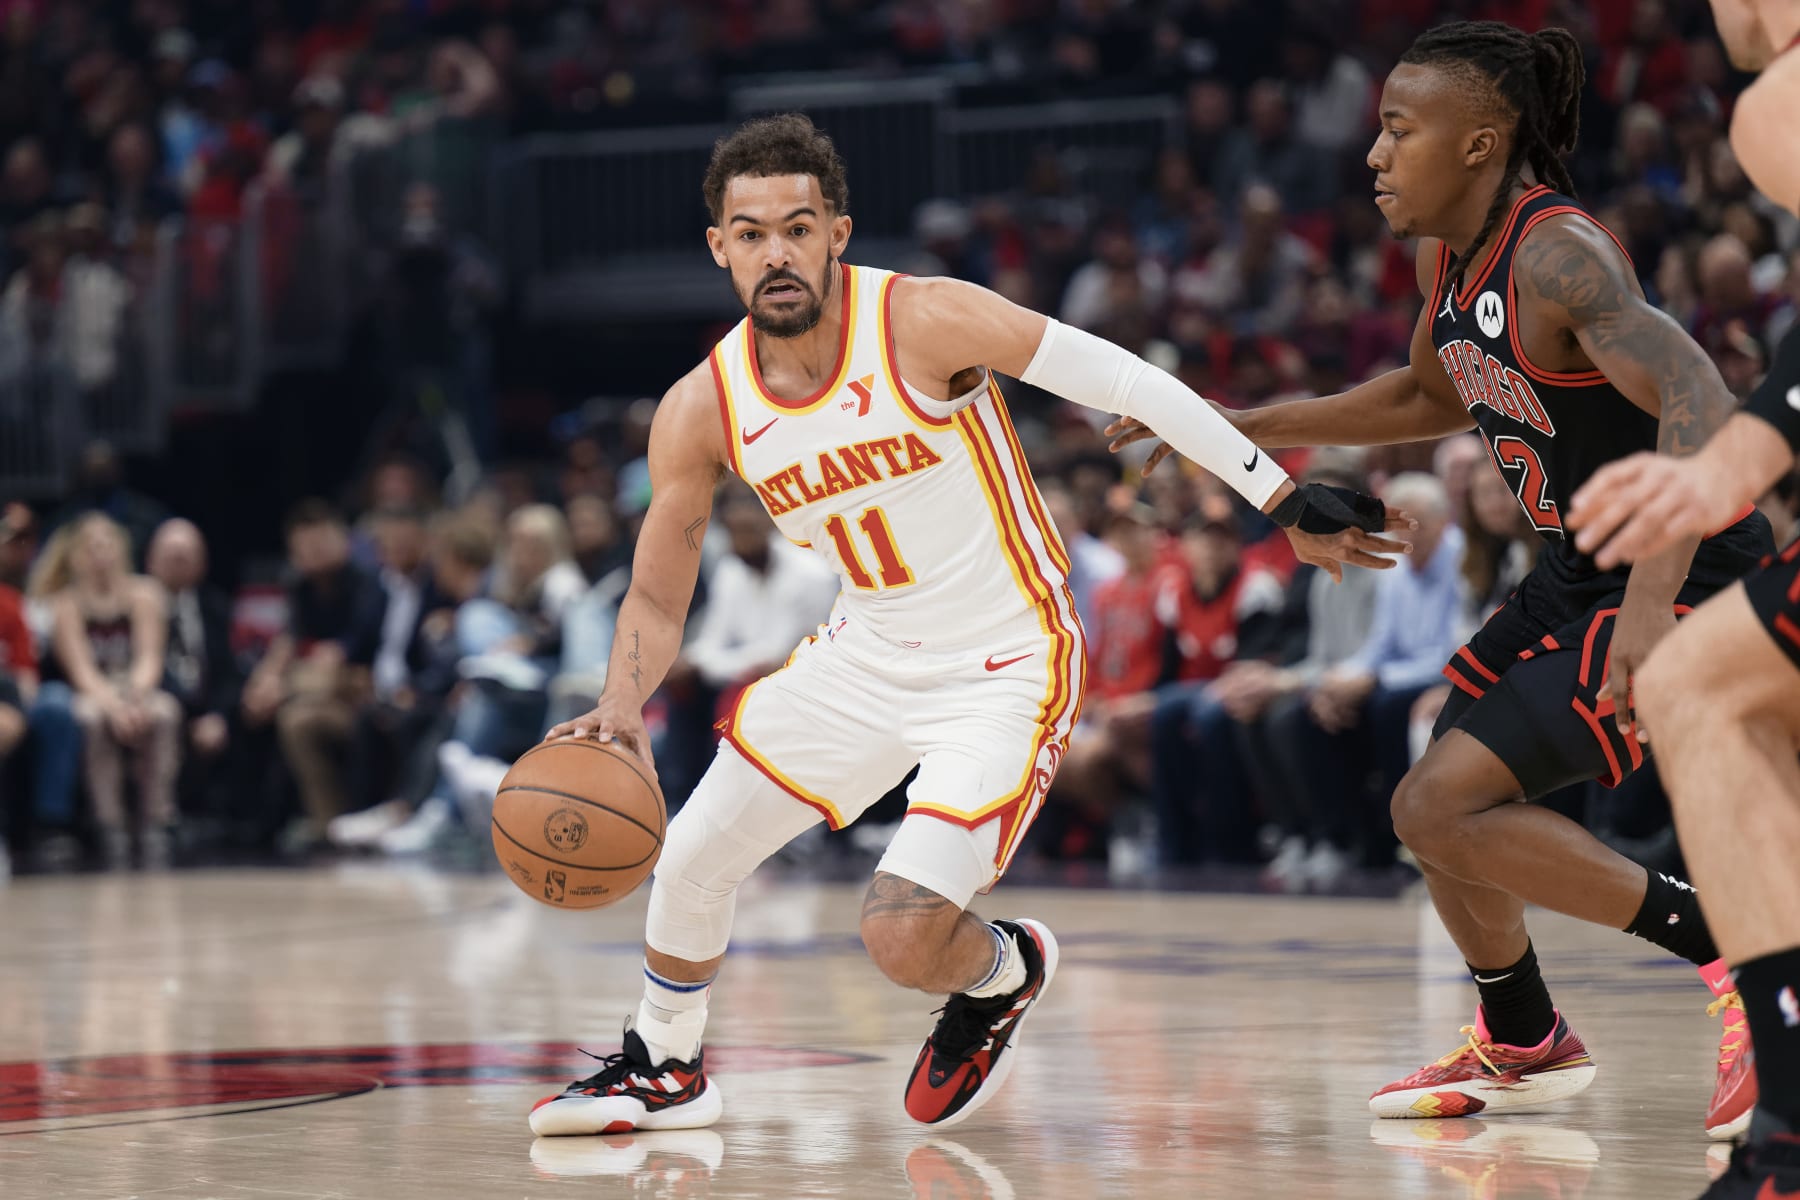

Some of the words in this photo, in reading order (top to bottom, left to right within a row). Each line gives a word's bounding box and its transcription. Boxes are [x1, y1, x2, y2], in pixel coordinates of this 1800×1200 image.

[840, 401, 856, 412] the
[1438, 339, 1556, 438] HICAGO
[755, 431, 943, 517] ATLANTA
[1479, 426, 1562, 532] 2
[824, 505, 916, 592] 11
